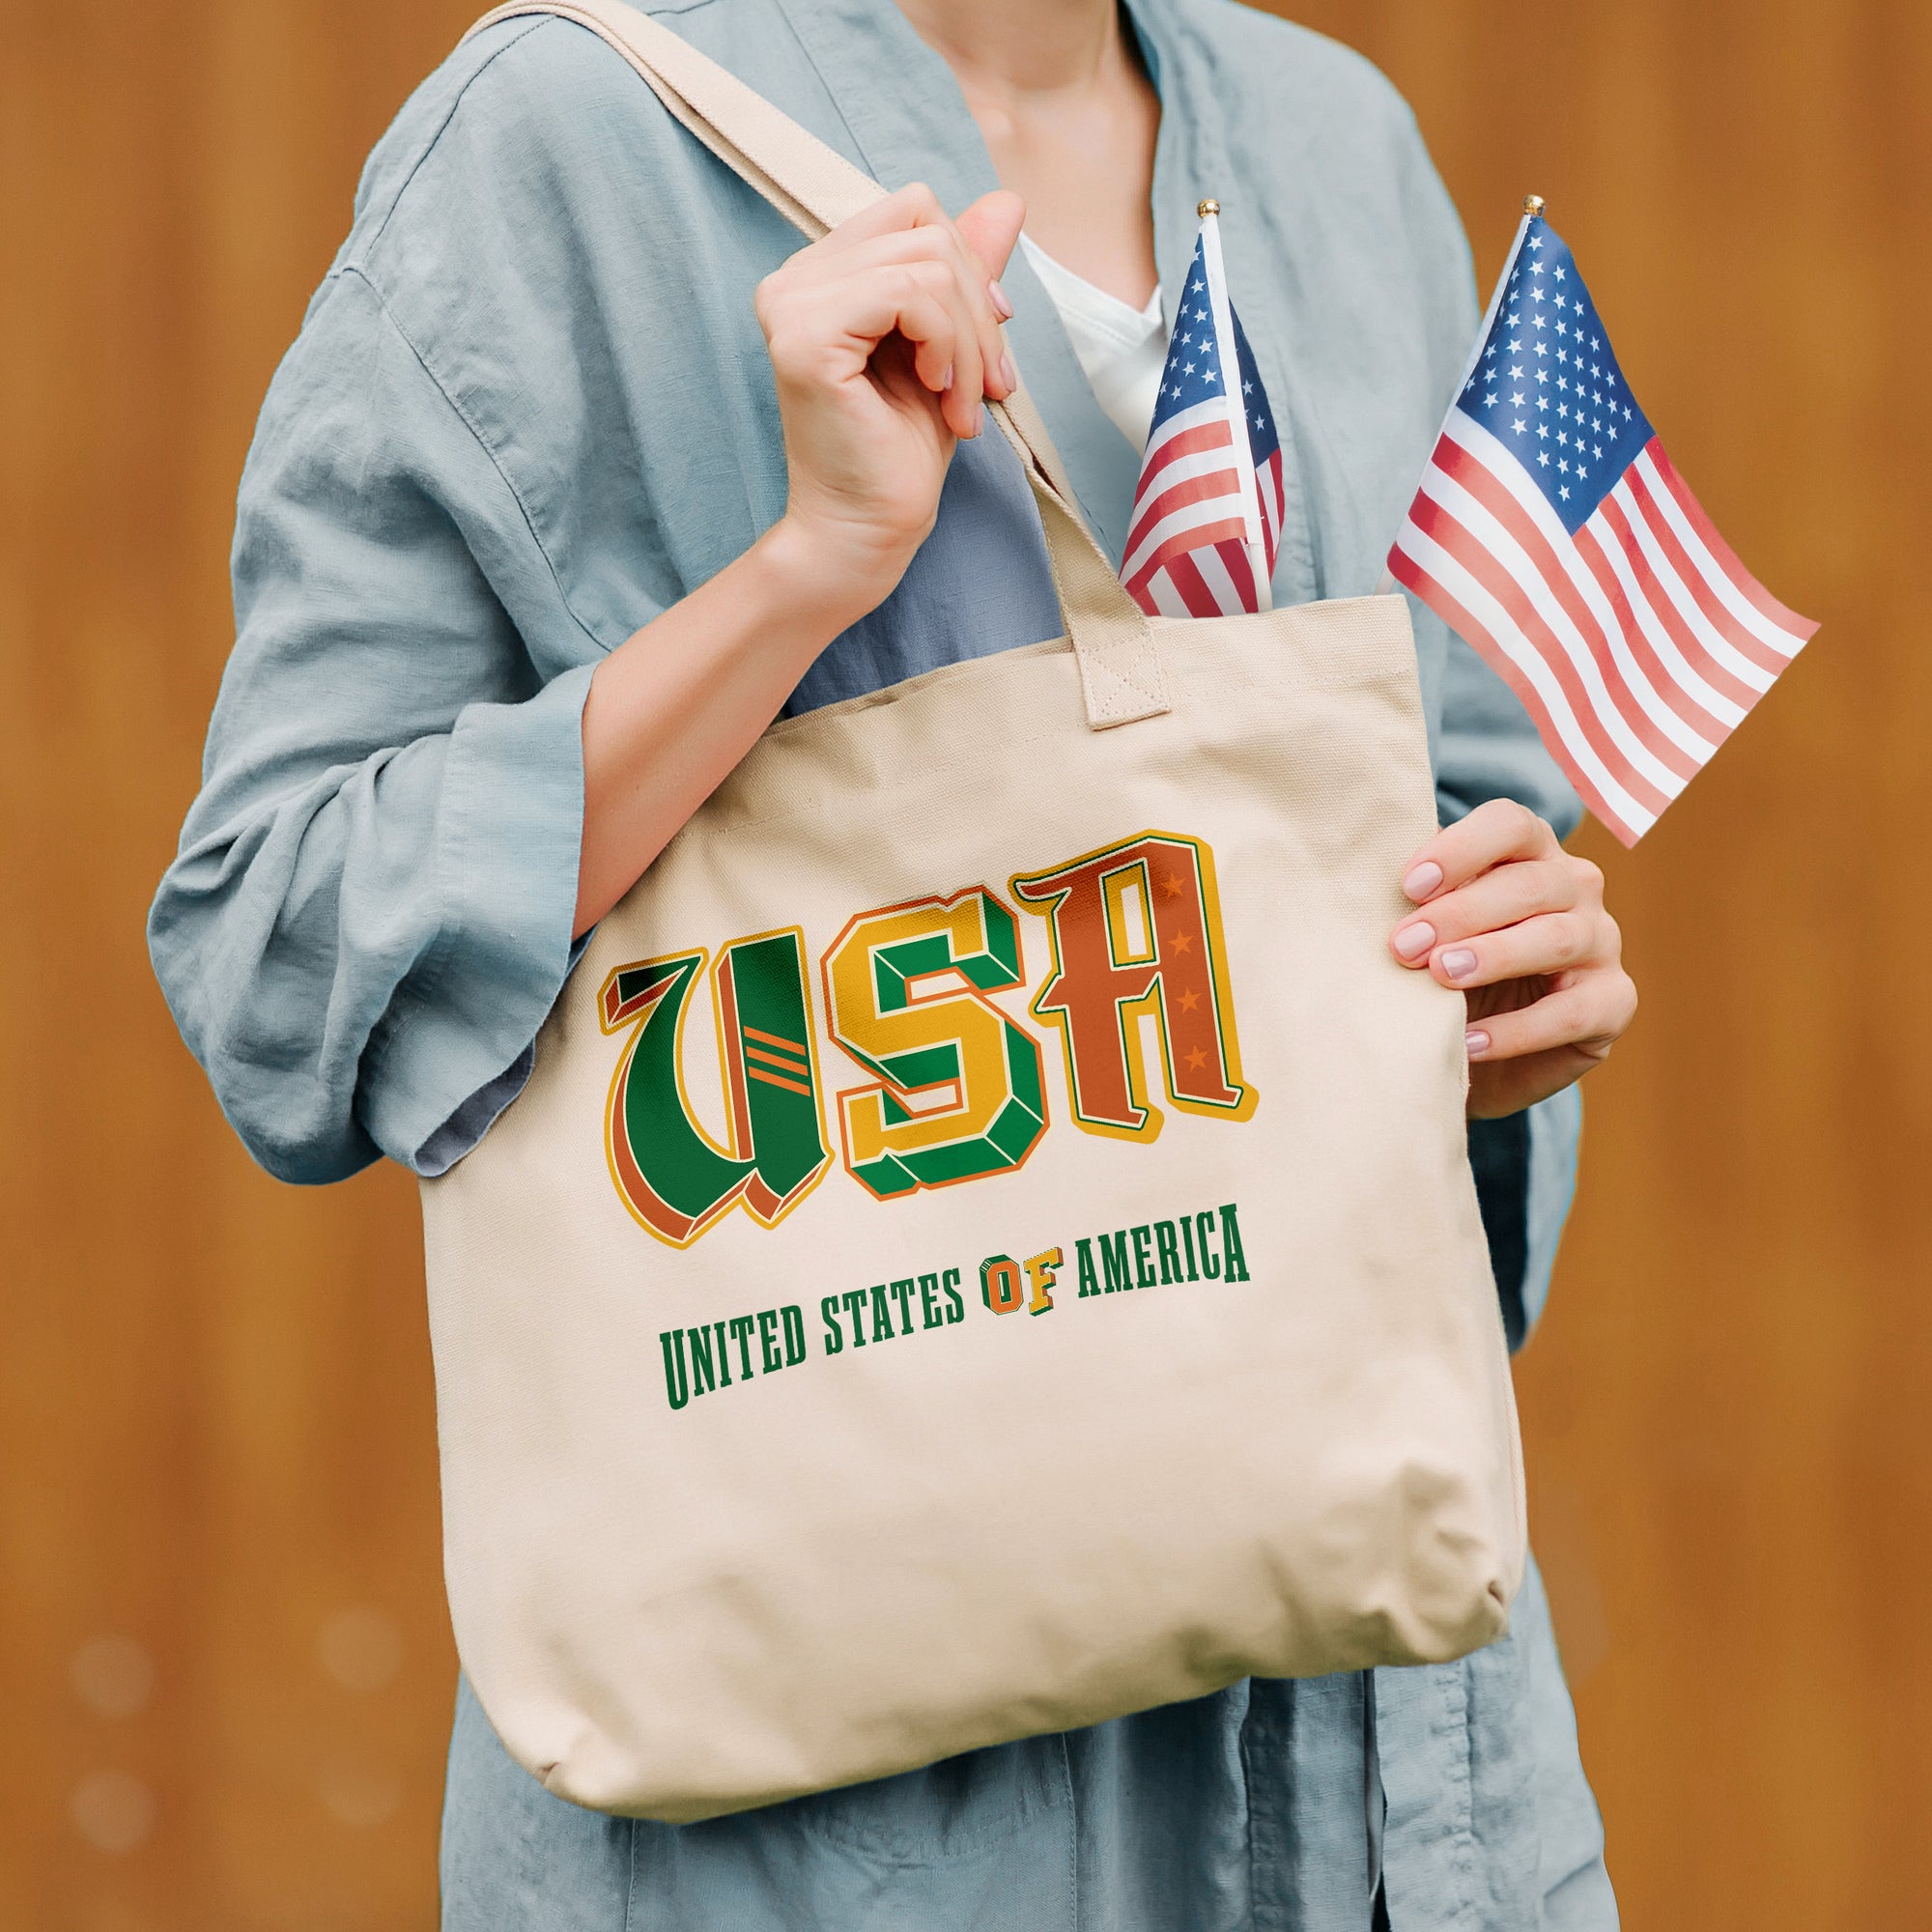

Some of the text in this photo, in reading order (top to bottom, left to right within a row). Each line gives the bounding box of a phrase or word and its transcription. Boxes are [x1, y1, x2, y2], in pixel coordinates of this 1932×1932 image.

[597, 829, 1260, 1250] USA
[659, 1204, 1250, 1411] UNITED STATES OF AMERICA
